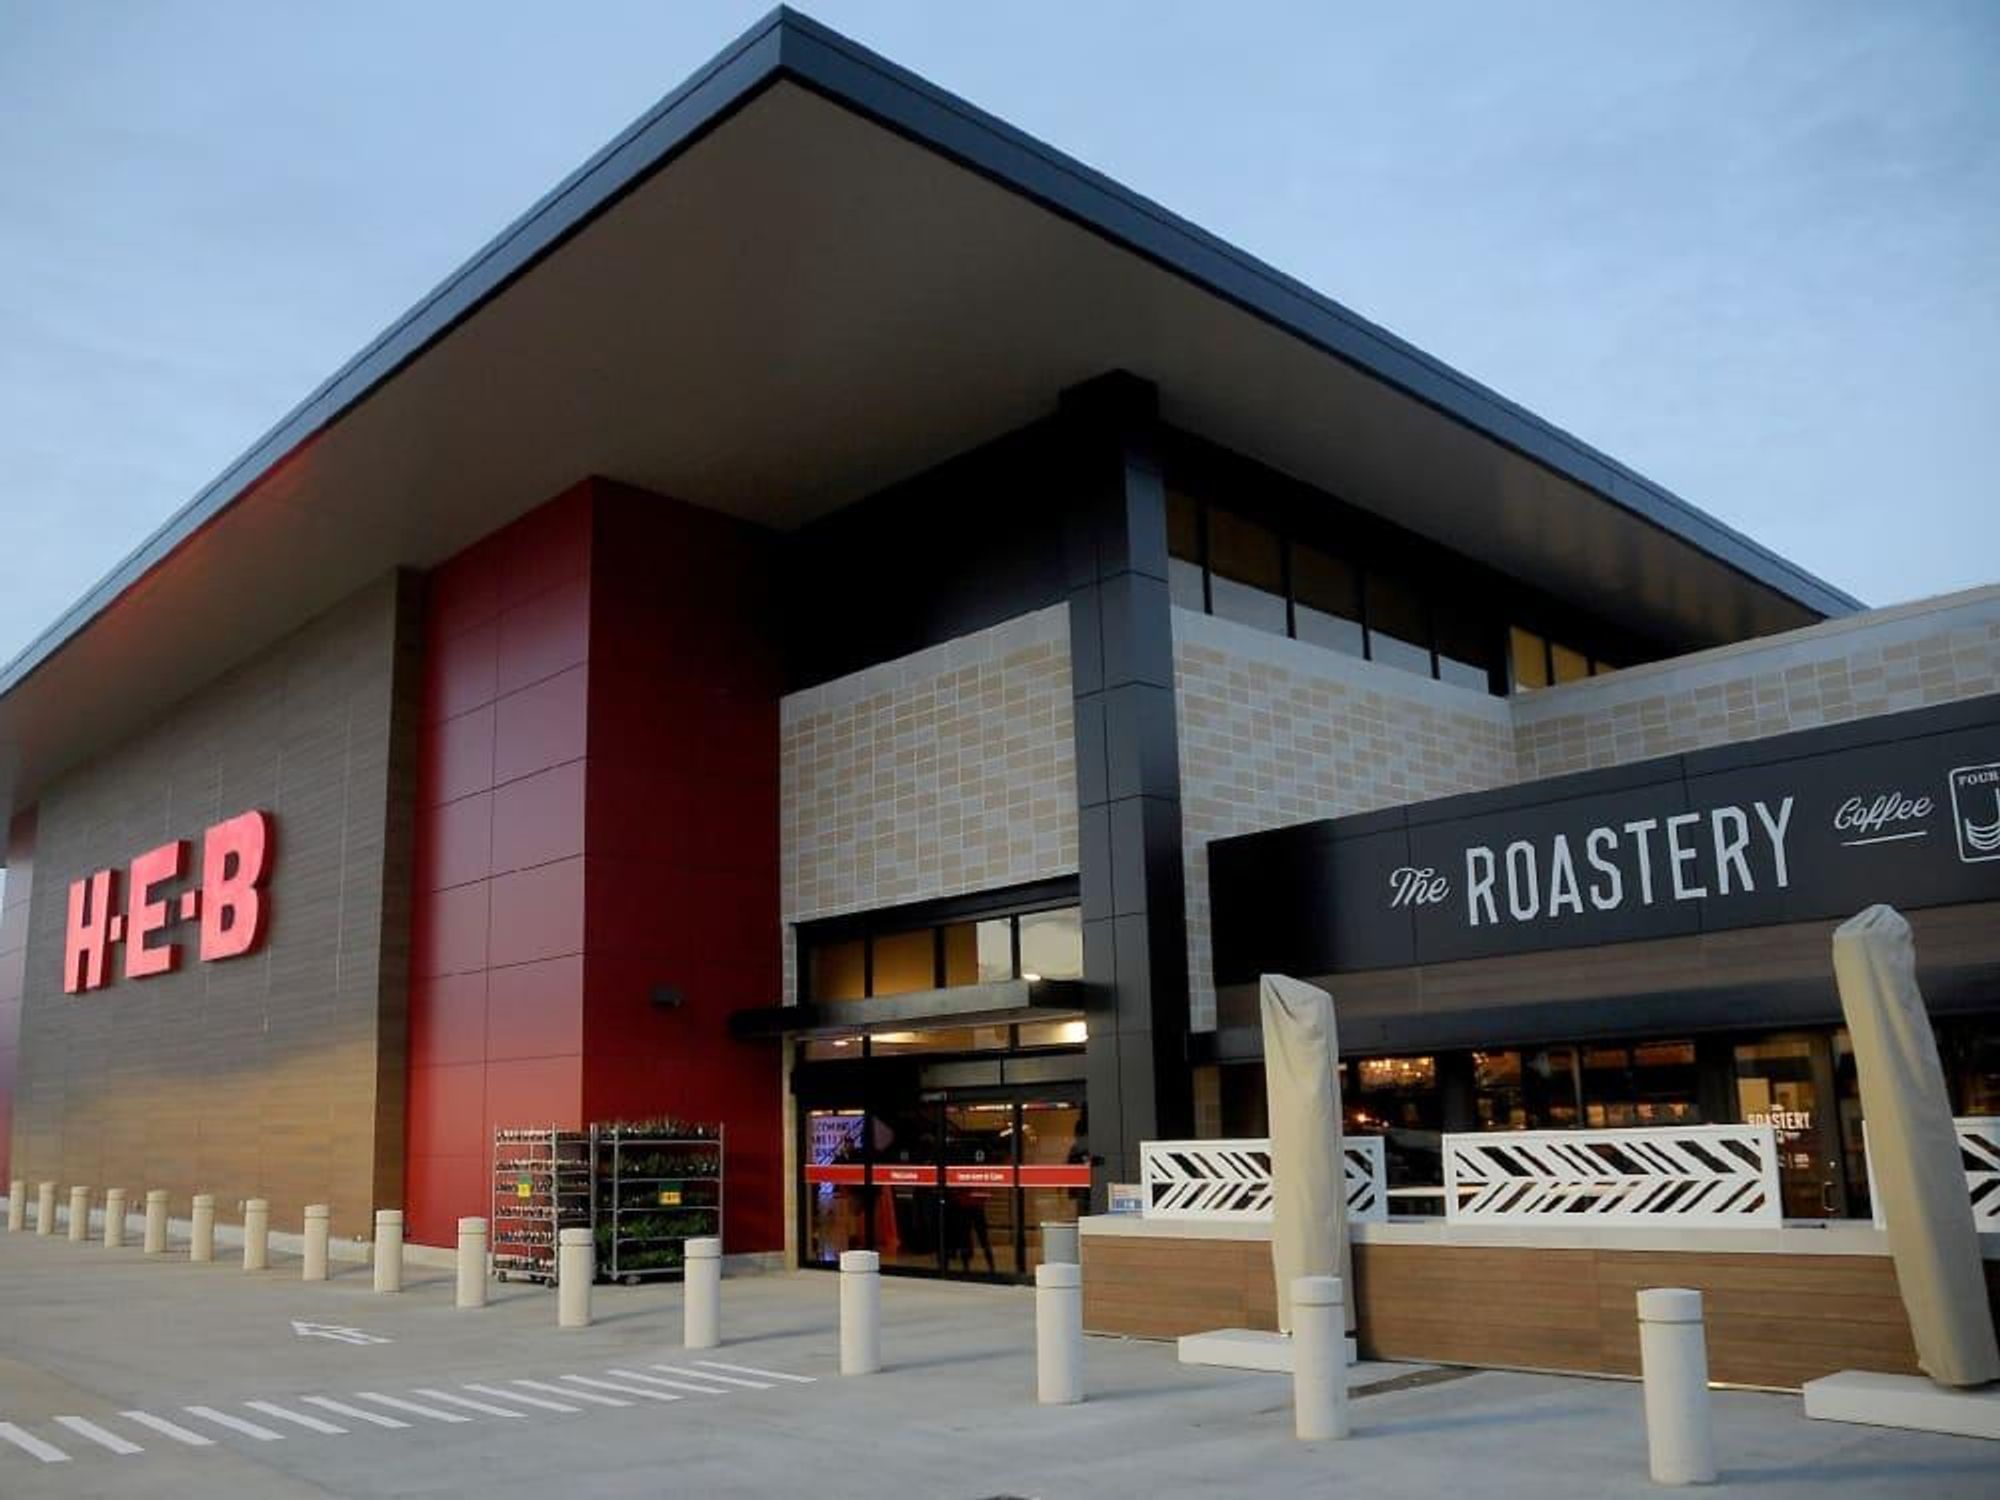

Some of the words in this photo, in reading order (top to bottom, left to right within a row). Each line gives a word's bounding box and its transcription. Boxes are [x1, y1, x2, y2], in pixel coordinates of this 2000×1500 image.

[1834, 791, 1936, 833] Coffee
[1389, 867, 1450, 908] The
[1465, 796, 1794, 926] ROASTERY
